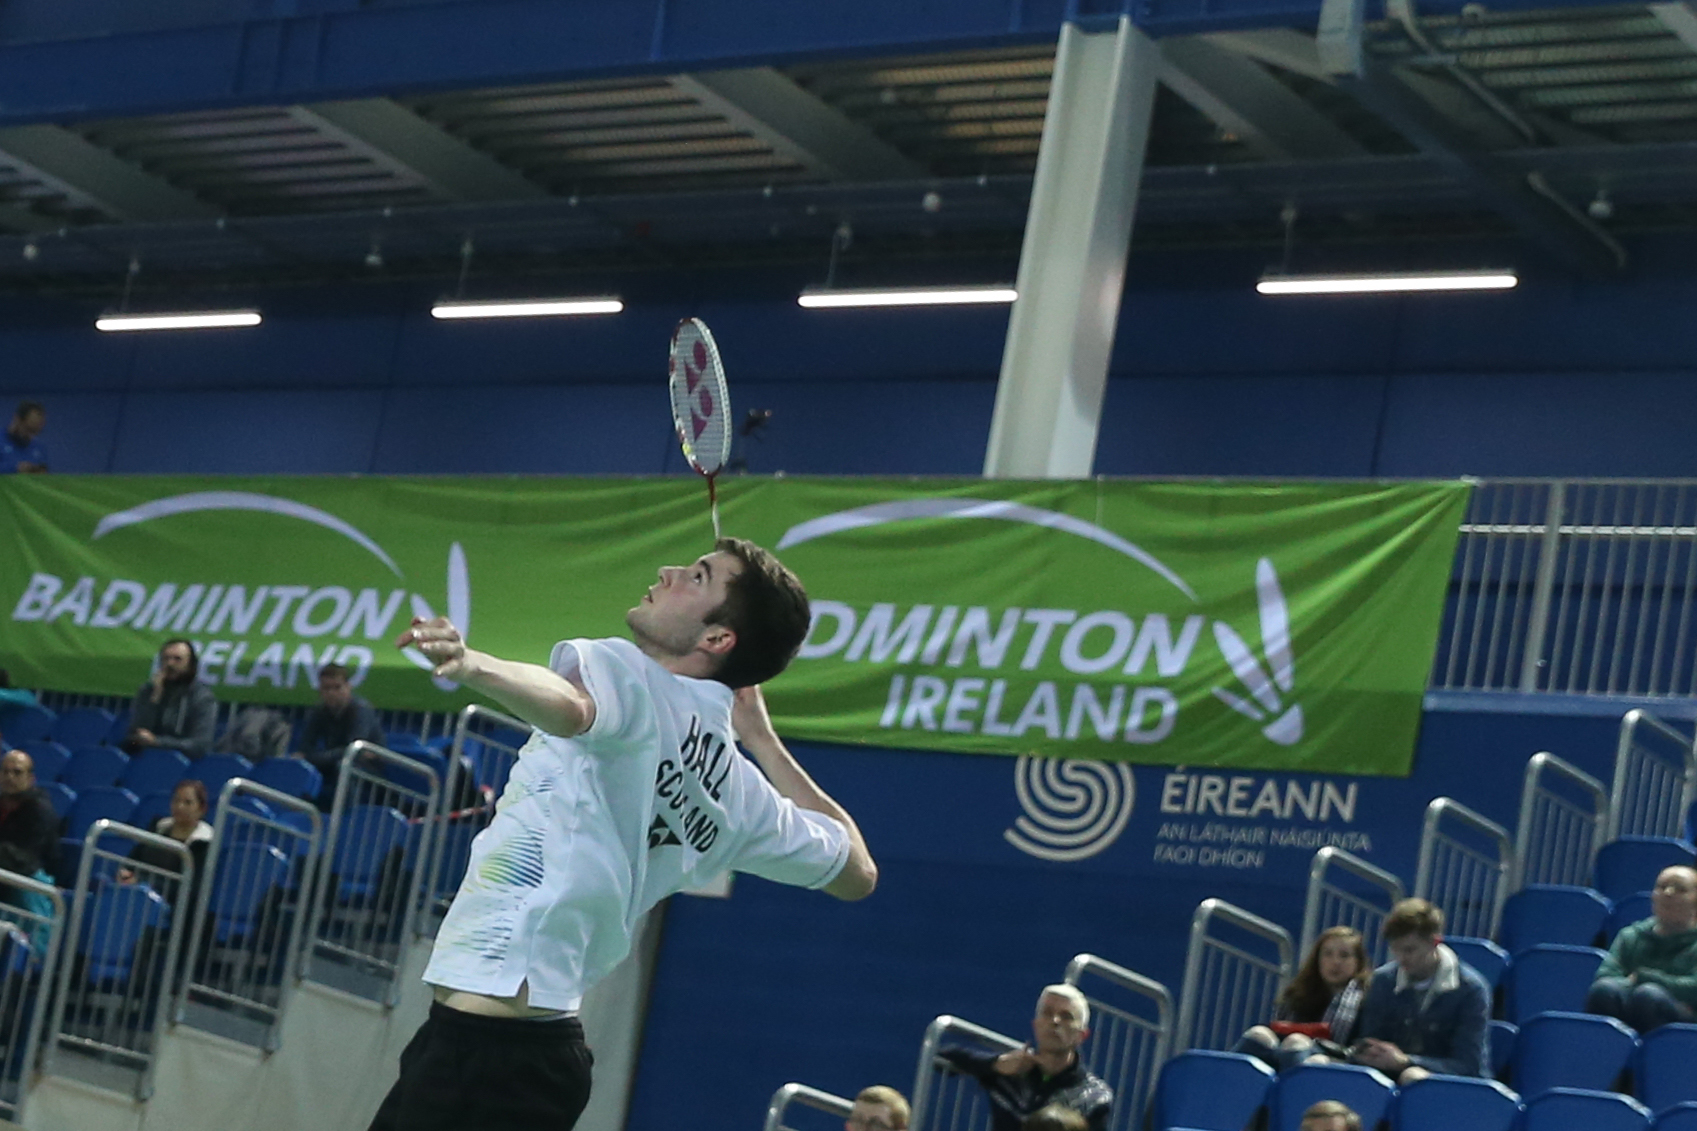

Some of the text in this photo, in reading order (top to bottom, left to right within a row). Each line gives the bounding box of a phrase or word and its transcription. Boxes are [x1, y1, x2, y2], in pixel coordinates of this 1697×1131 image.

[11, 571, 405, 640] BADMINTON
[796, 600, 1204, 678] DMINTON
[151, 640, 374, 690] ELAND
[879, 674, 1178, 744] IRELAND
[680, 714, 733, 803] HALL
[1160, 765, 1359, 823] ÉIREANN
[1157, 822, 1184, 841] AN
